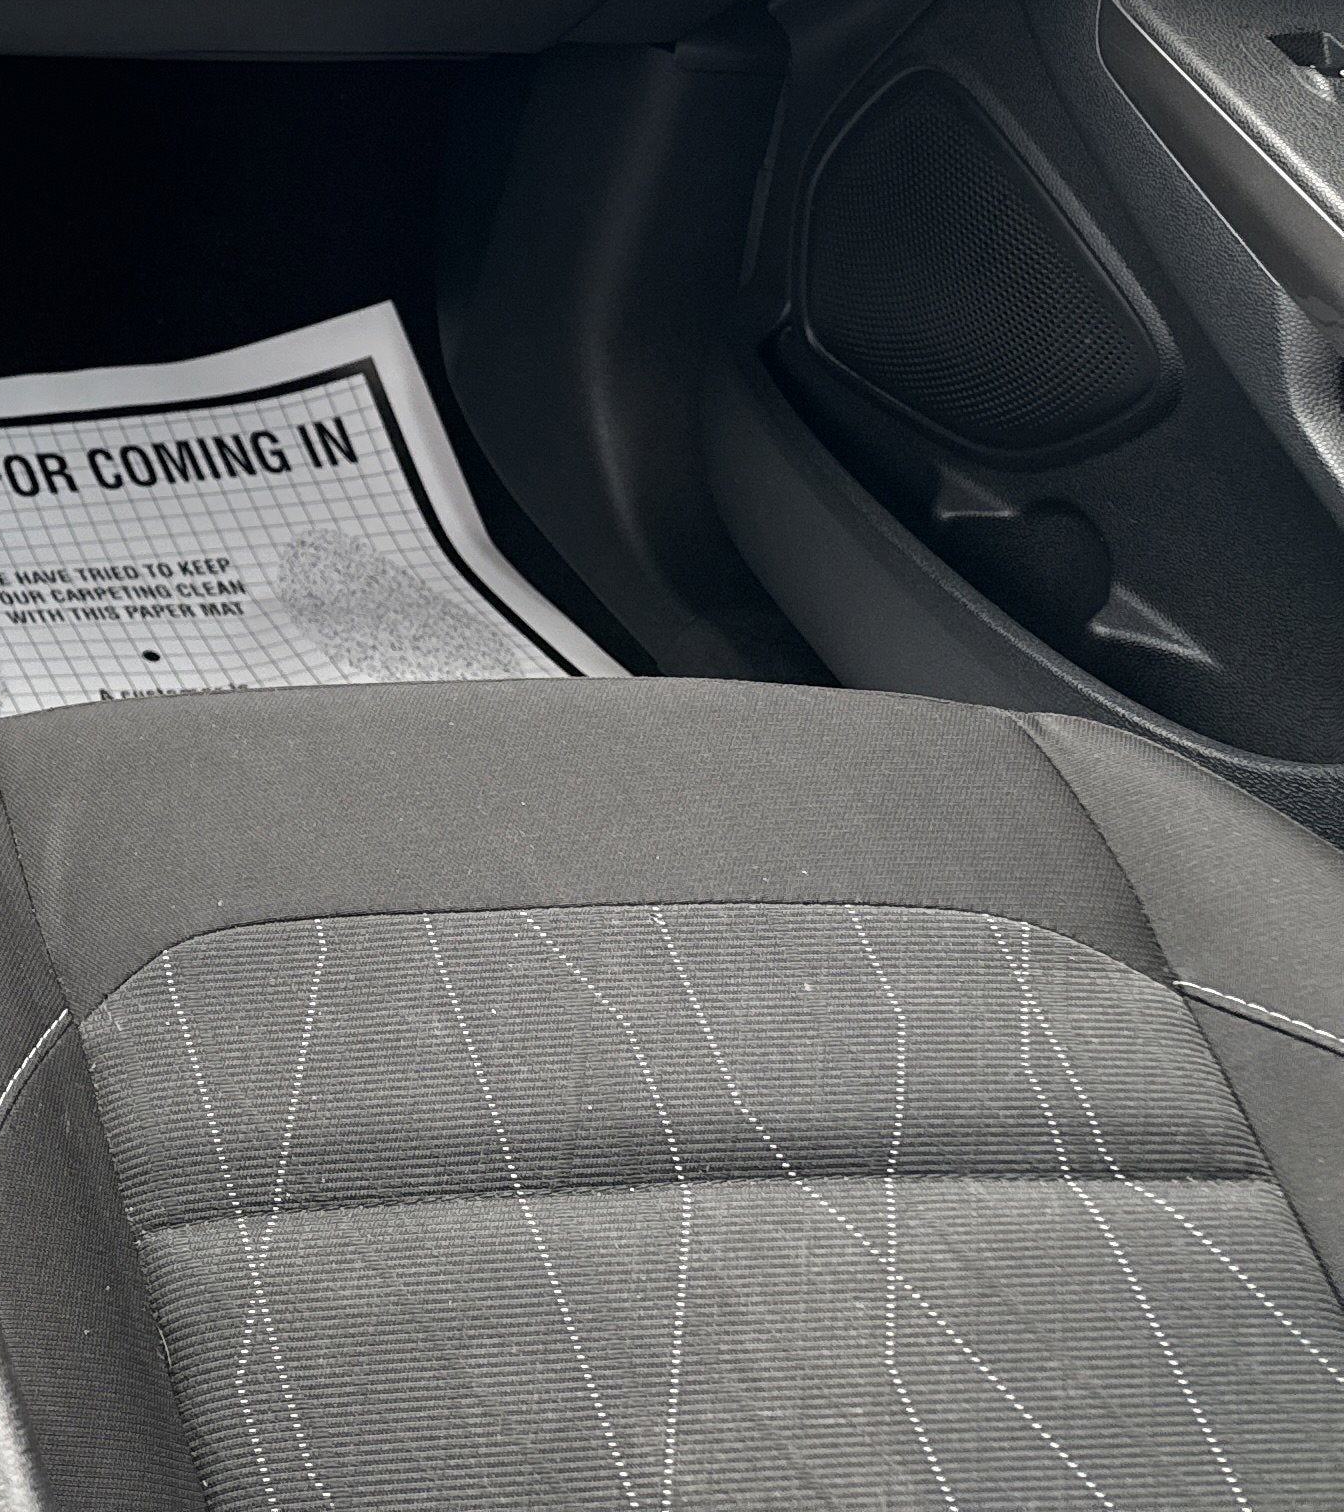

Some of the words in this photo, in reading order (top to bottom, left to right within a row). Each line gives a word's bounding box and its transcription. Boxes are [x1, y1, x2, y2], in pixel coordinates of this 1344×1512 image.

[88, 430, 292, 490] COMING
[298, 417, 360, 468] IN
[20, 567, 71, 588] HAVE
[76, 562, 138, 584] TRIED
[143, 561, 172, 581] TO
[178, 556, 231, 578] KEEP
[49, 583, 172, 605] CARPETING
[176, 578, 246, 599] CLEAN
[5, 603, 59, 624] WITH
[67, 601, 121, 621] THIS
[124, 599, 195, 620] PAPER
[200, 597, 245, 618] MAT
